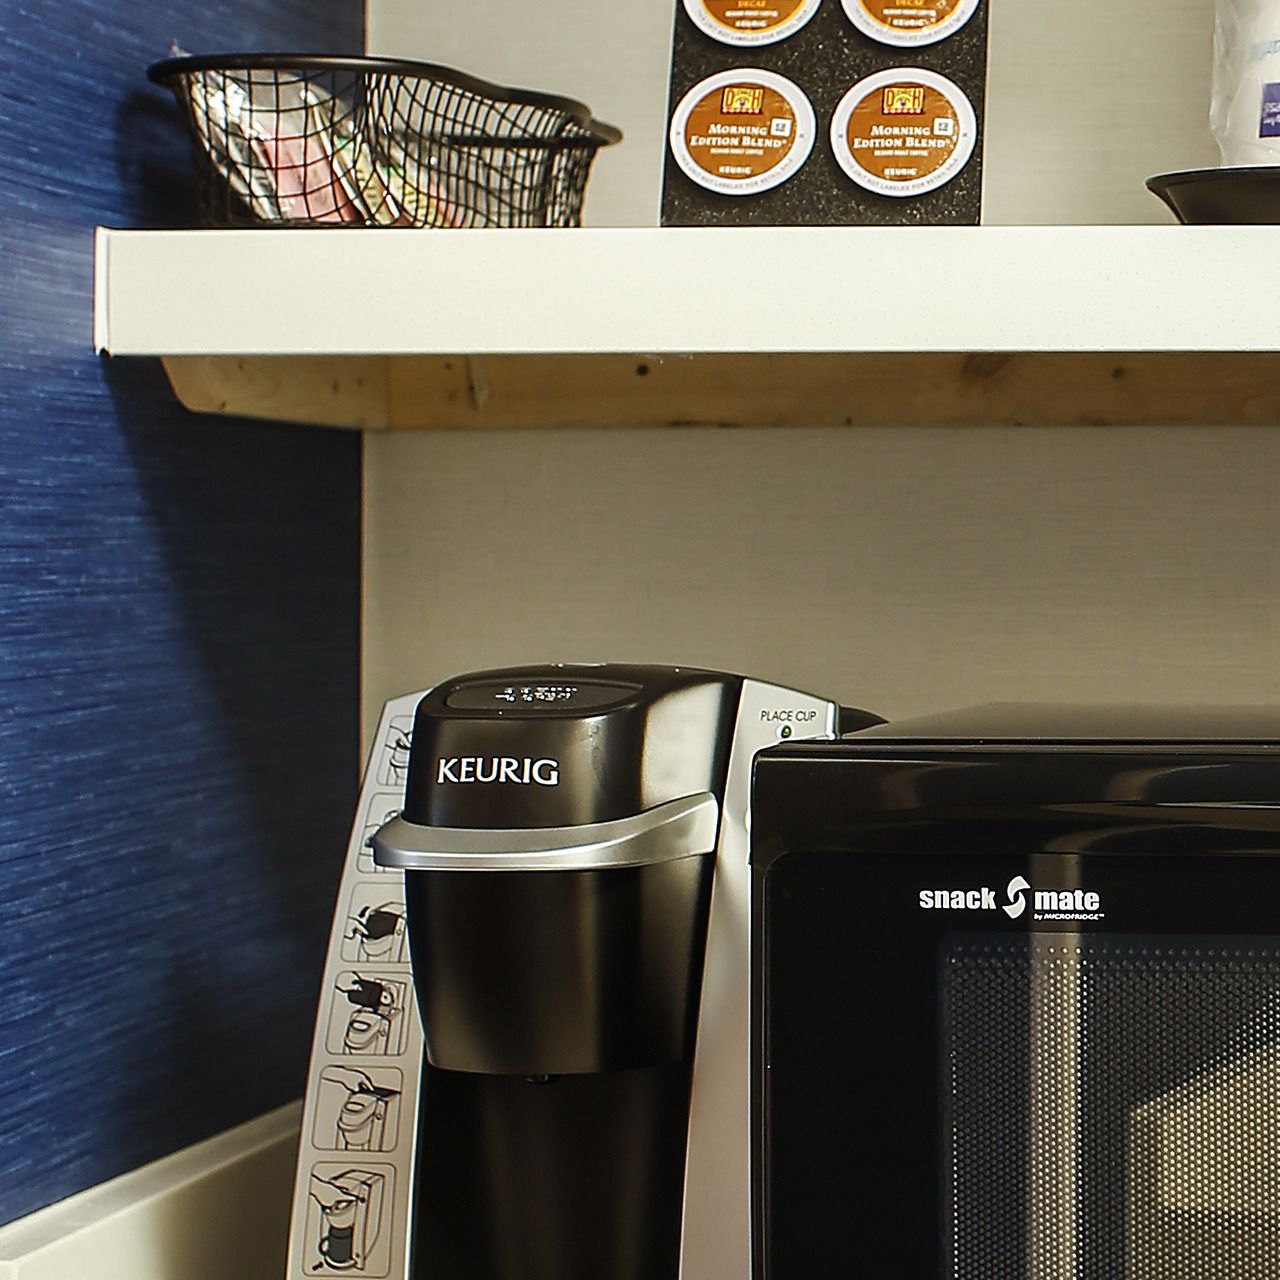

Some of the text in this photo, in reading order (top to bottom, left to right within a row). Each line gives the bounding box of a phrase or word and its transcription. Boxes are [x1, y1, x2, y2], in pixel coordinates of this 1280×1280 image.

[708, 124, 768, 136] MORNING
[870, 125, 931, 136] MORNING
[690, 135, 739, 146] EDITION
[853, 137, 902, 149] EDITION
[760, 710, 817, 722] PLACE CUP
[437, 757, 560, 786] KEURIG
[918, 886, 1101, 912] snack mate
